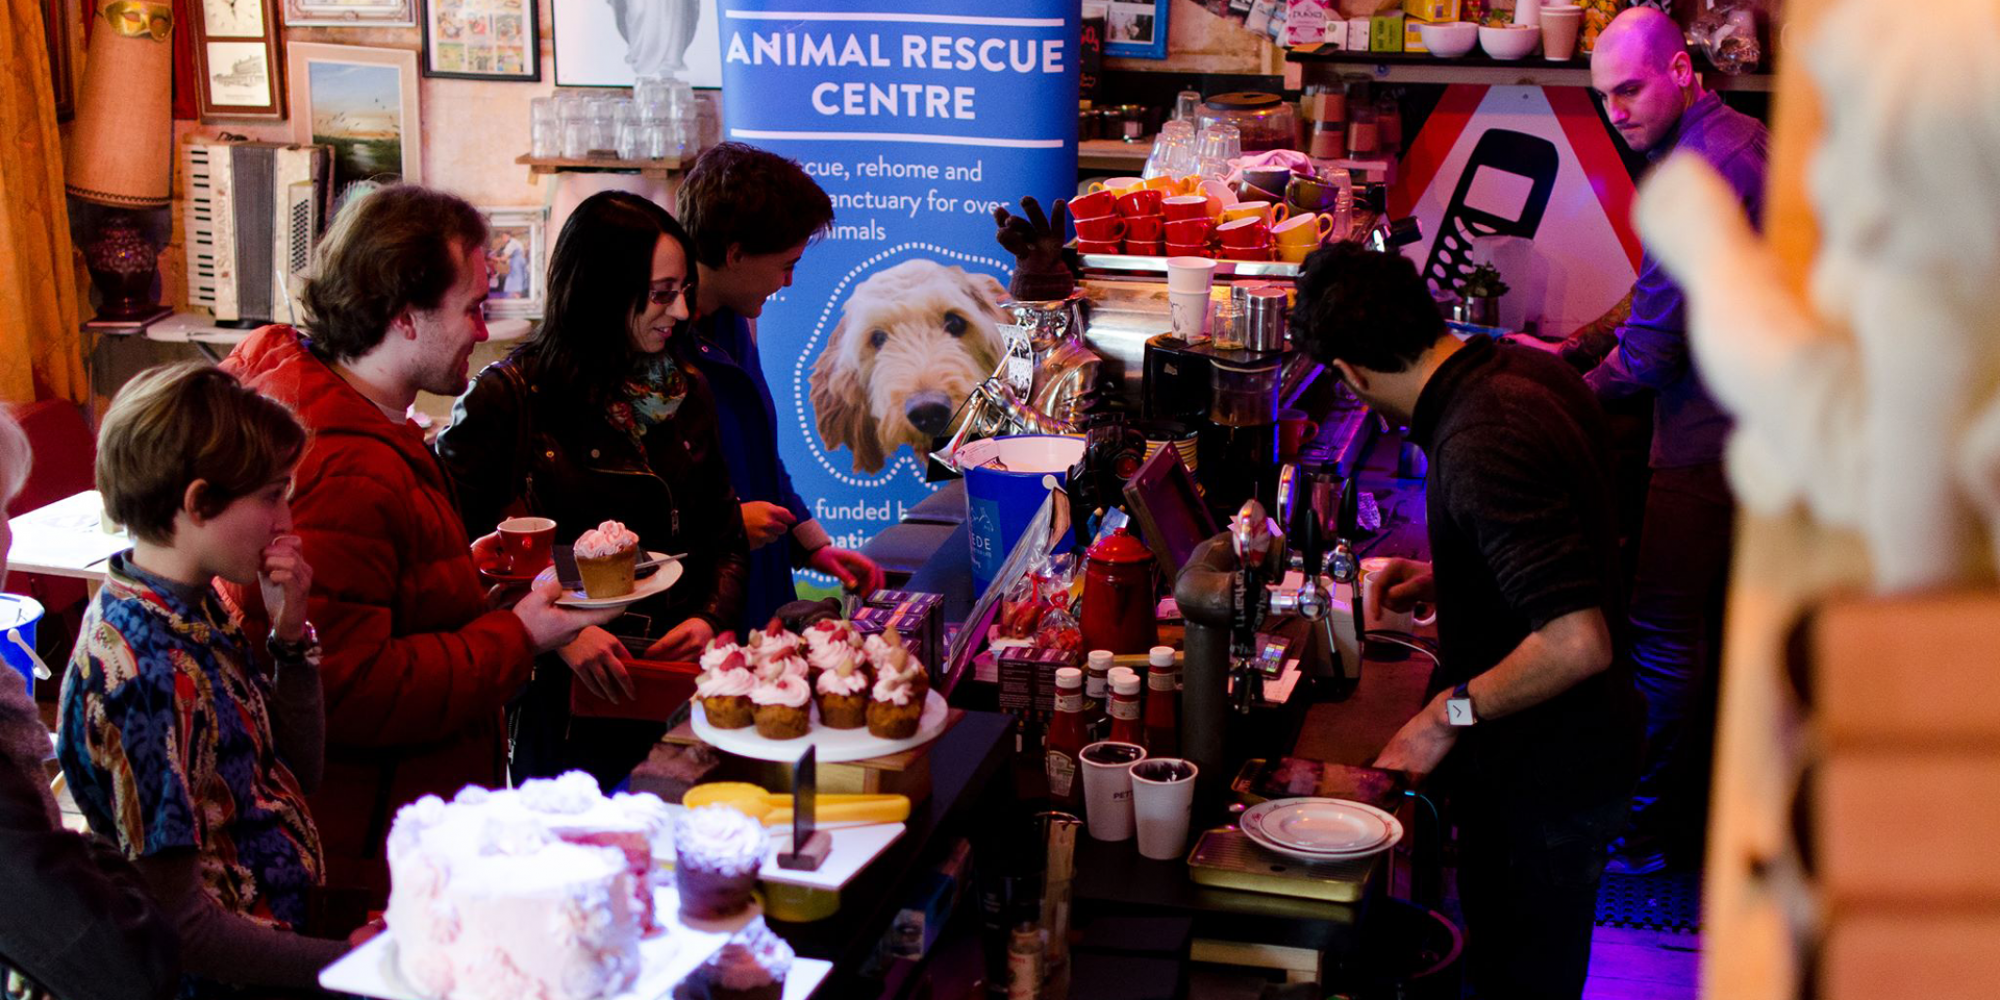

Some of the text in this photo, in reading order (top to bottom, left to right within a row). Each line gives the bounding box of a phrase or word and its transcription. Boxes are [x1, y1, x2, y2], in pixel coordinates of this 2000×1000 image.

[726, 31, 890, 67] ANIMAL
[902, 35, 1065, 73] RESCUE
[811, 82, 976, 120] CENTRE
[857, 155, 939, 180] rehome
[945, 160, 982, 182] and
[829, 191, 922, 218] anctuary
[927, 190, 957, 212] for
[816, 498, 890, 521] funded
